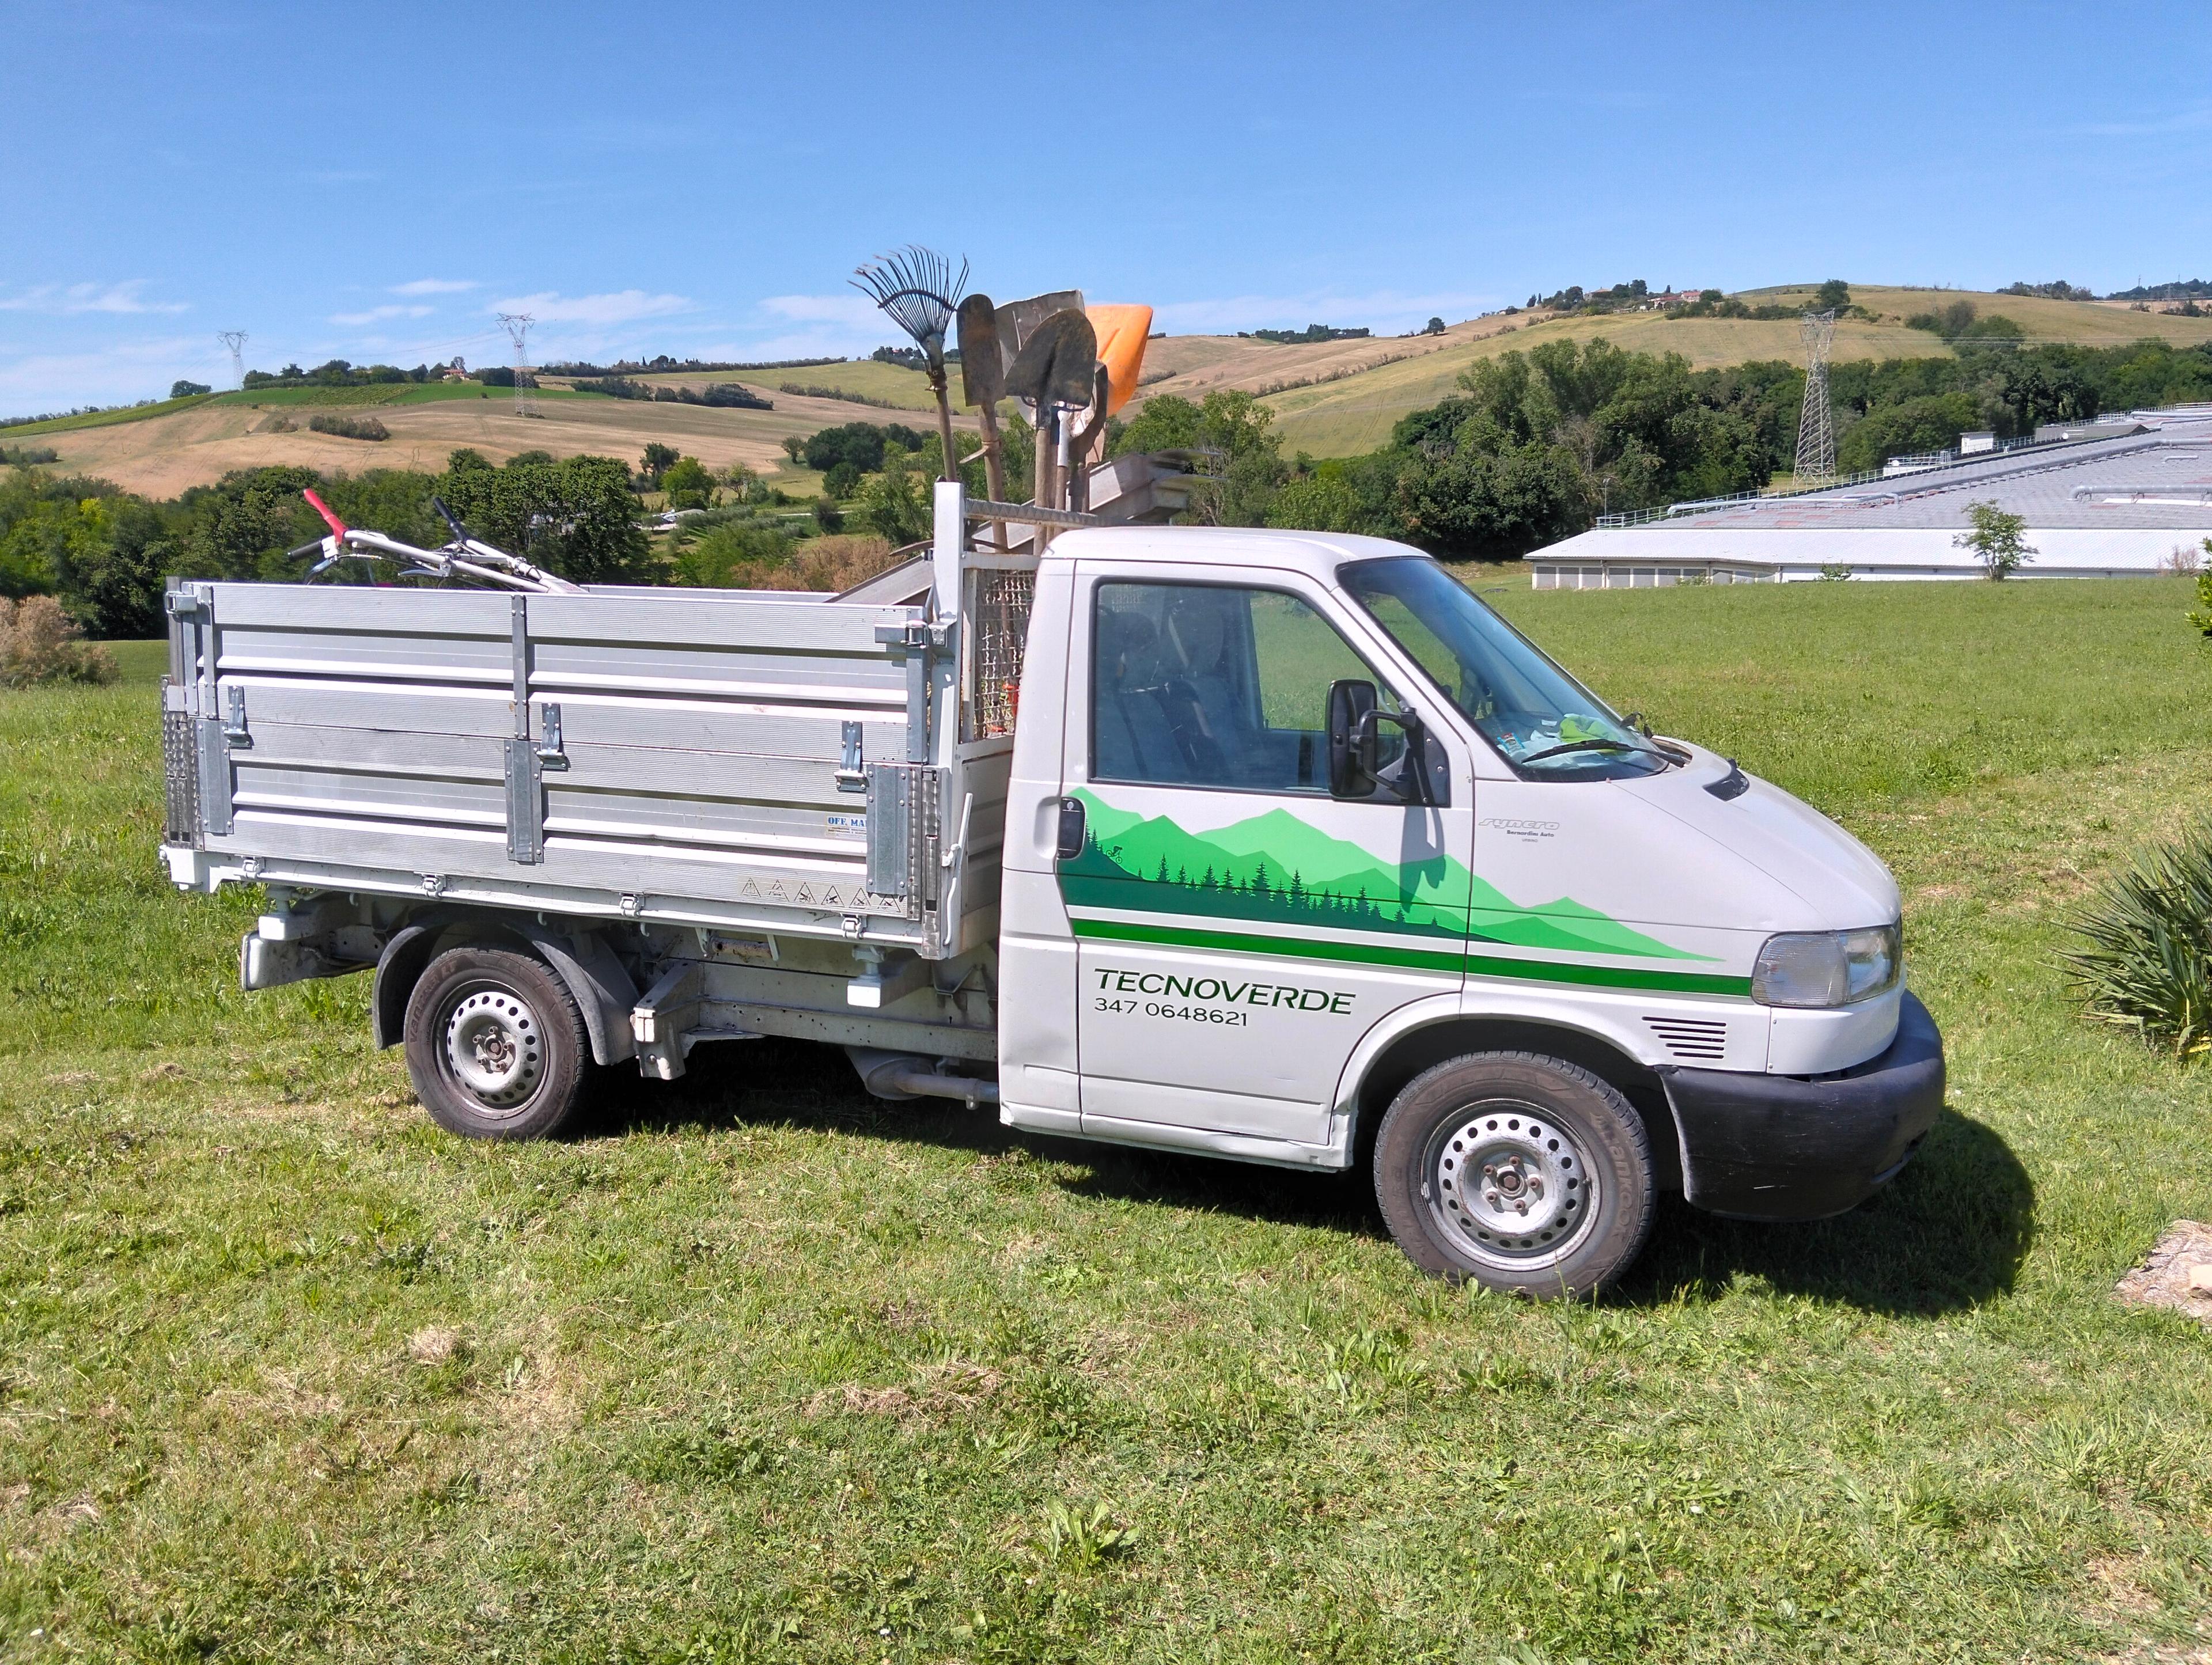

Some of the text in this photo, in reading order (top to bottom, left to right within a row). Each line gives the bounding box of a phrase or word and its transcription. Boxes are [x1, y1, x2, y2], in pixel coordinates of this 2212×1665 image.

[828, 817, 867, 828] OFF. MA
[1094, 968, 1357, 1015] TECNOVERDE
[1094, 998, 1248, 1027] 347 0648621
